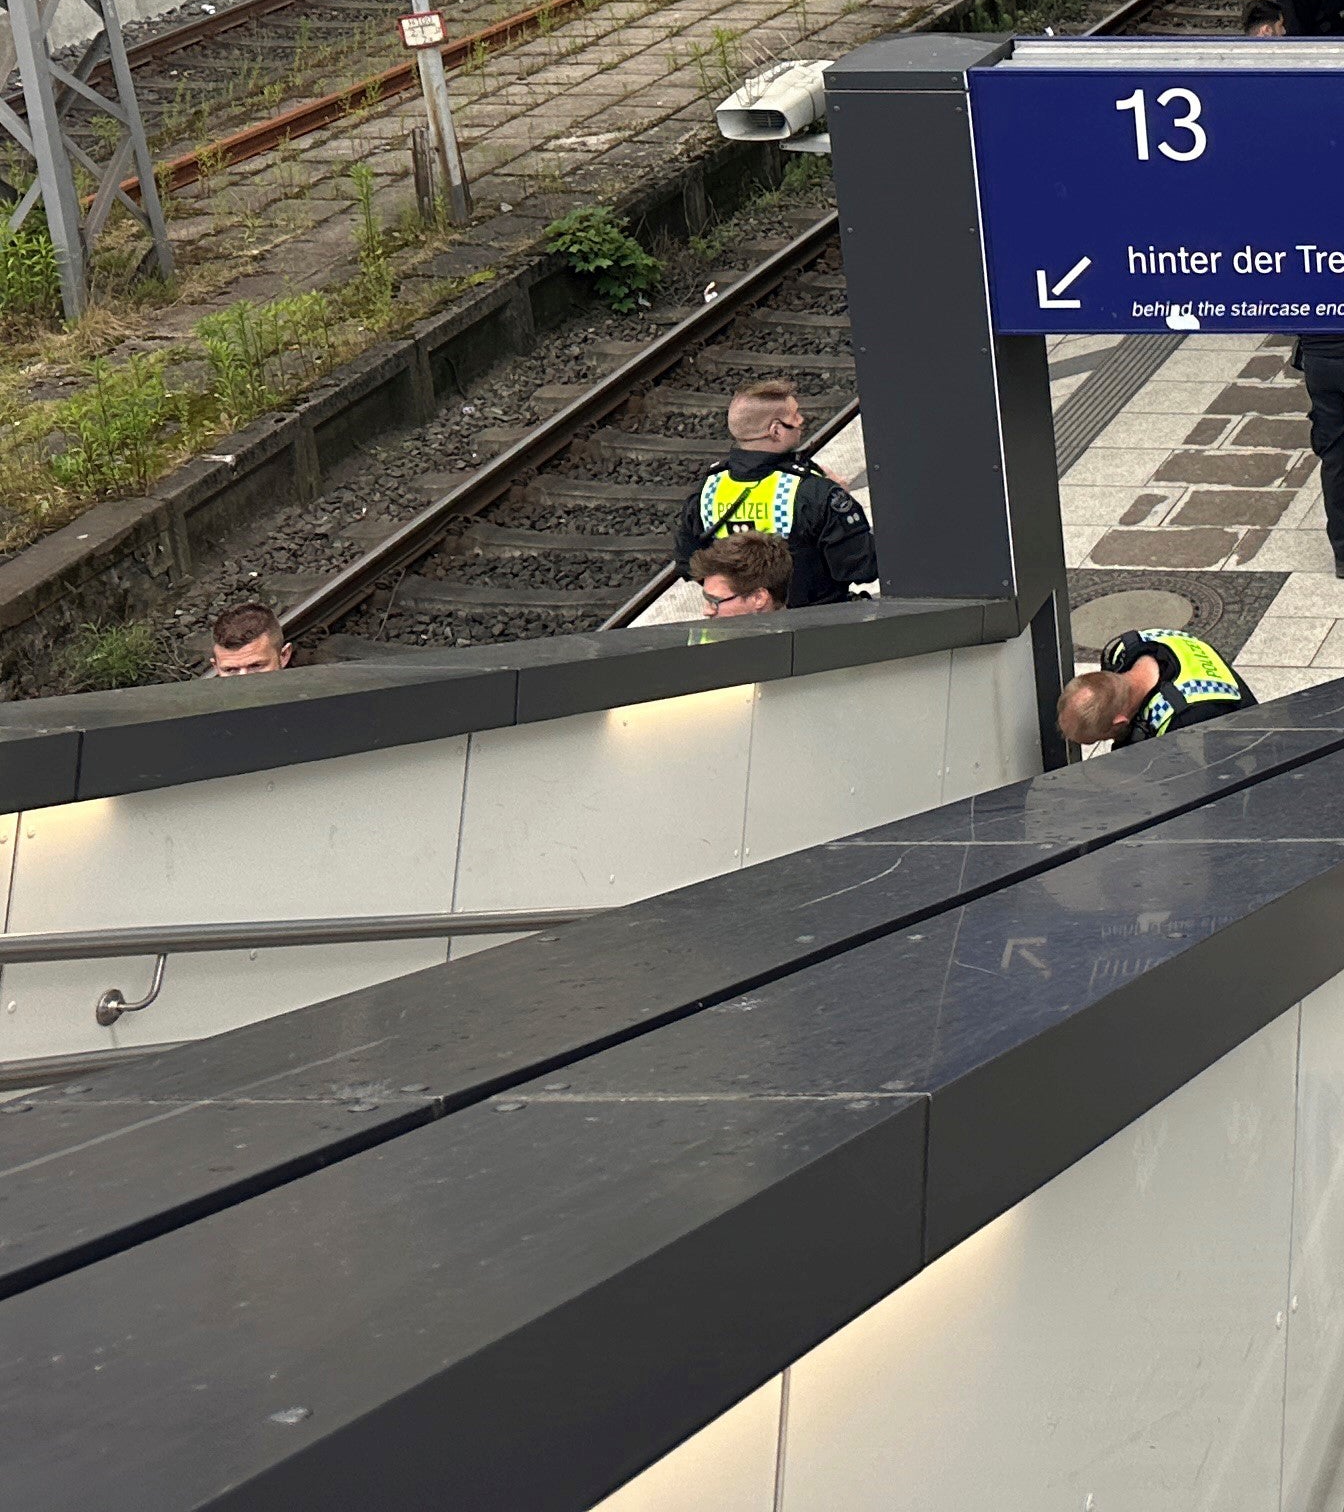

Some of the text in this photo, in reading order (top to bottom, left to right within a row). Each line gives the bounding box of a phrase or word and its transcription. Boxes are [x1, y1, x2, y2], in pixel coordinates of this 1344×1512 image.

[1115, 87, 1207, 162] 13
[1127, 245, 1223, 274] hinter
[1232, 245, 1287, 274] der
[1132, 300, 1193, 317] behind
[1197, 300, 1226, 317] the
[1230, 300, 1311, 317] staircase
